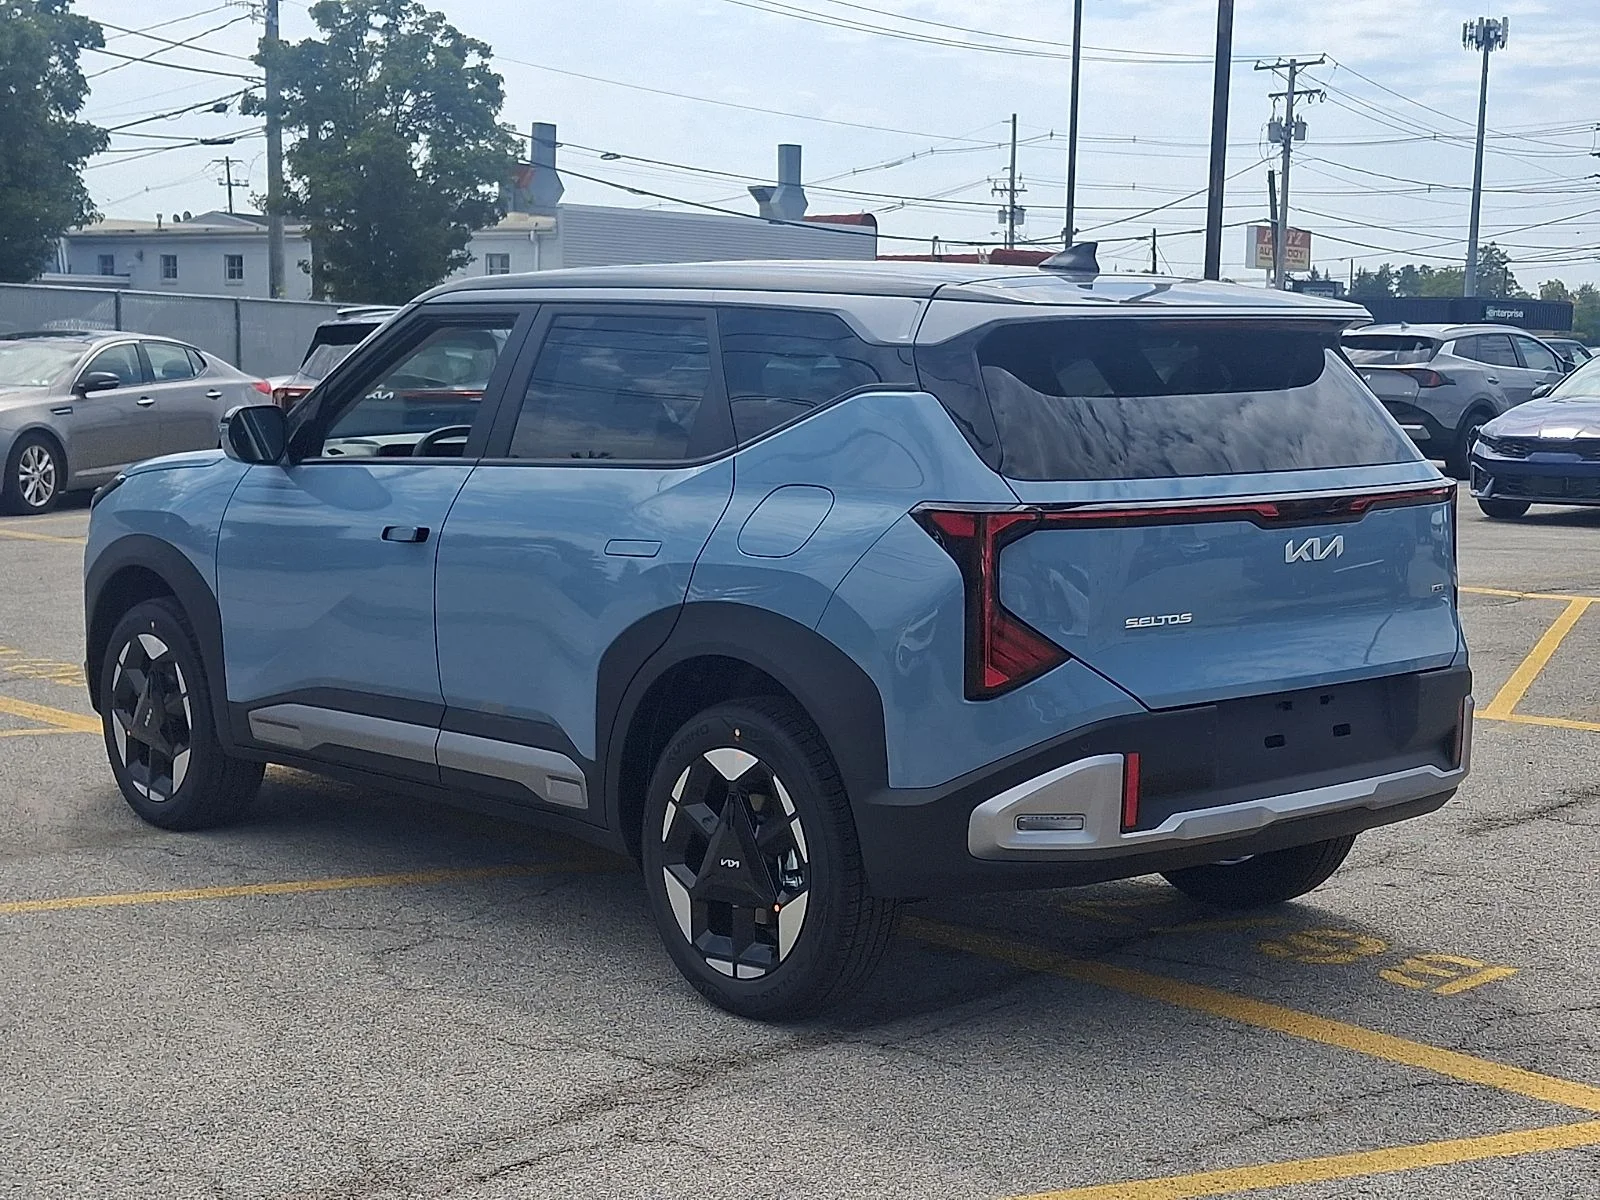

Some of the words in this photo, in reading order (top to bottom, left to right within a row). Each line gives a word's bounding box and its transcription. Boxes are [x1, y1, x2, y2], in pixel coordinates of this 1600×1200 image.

[1264, 230, 1303, 245] PTZ
[1487, 307, 1524, 319] enterprise
[1285, 535, 1344, 563] KIA
[1125, 612, 1193, 629] SELTOS
